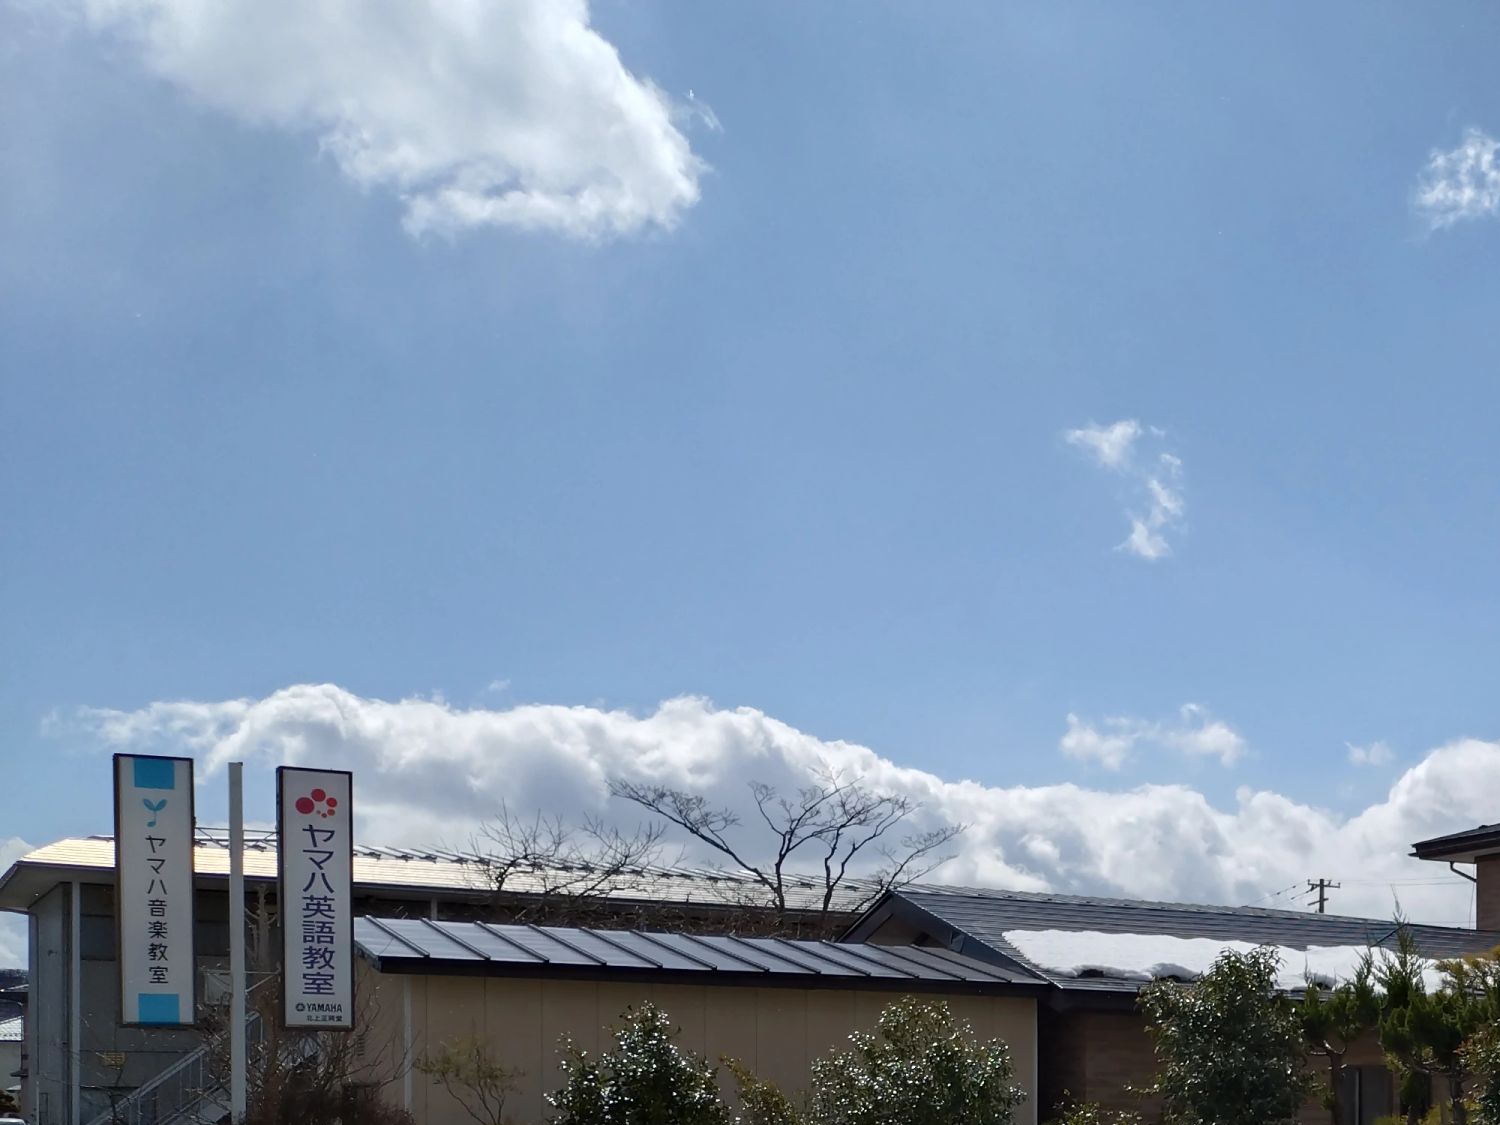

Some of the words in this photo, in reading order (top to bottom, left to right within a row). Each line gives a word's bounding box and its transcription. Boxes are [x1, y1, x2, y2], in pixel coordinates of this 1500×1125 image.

[145, 835, 169, 984] ヤマハ音楽教室
[302, 824, 335, 996] ヤマハ英語教室
[307, 1002, 343, 1013] YAMAHA
